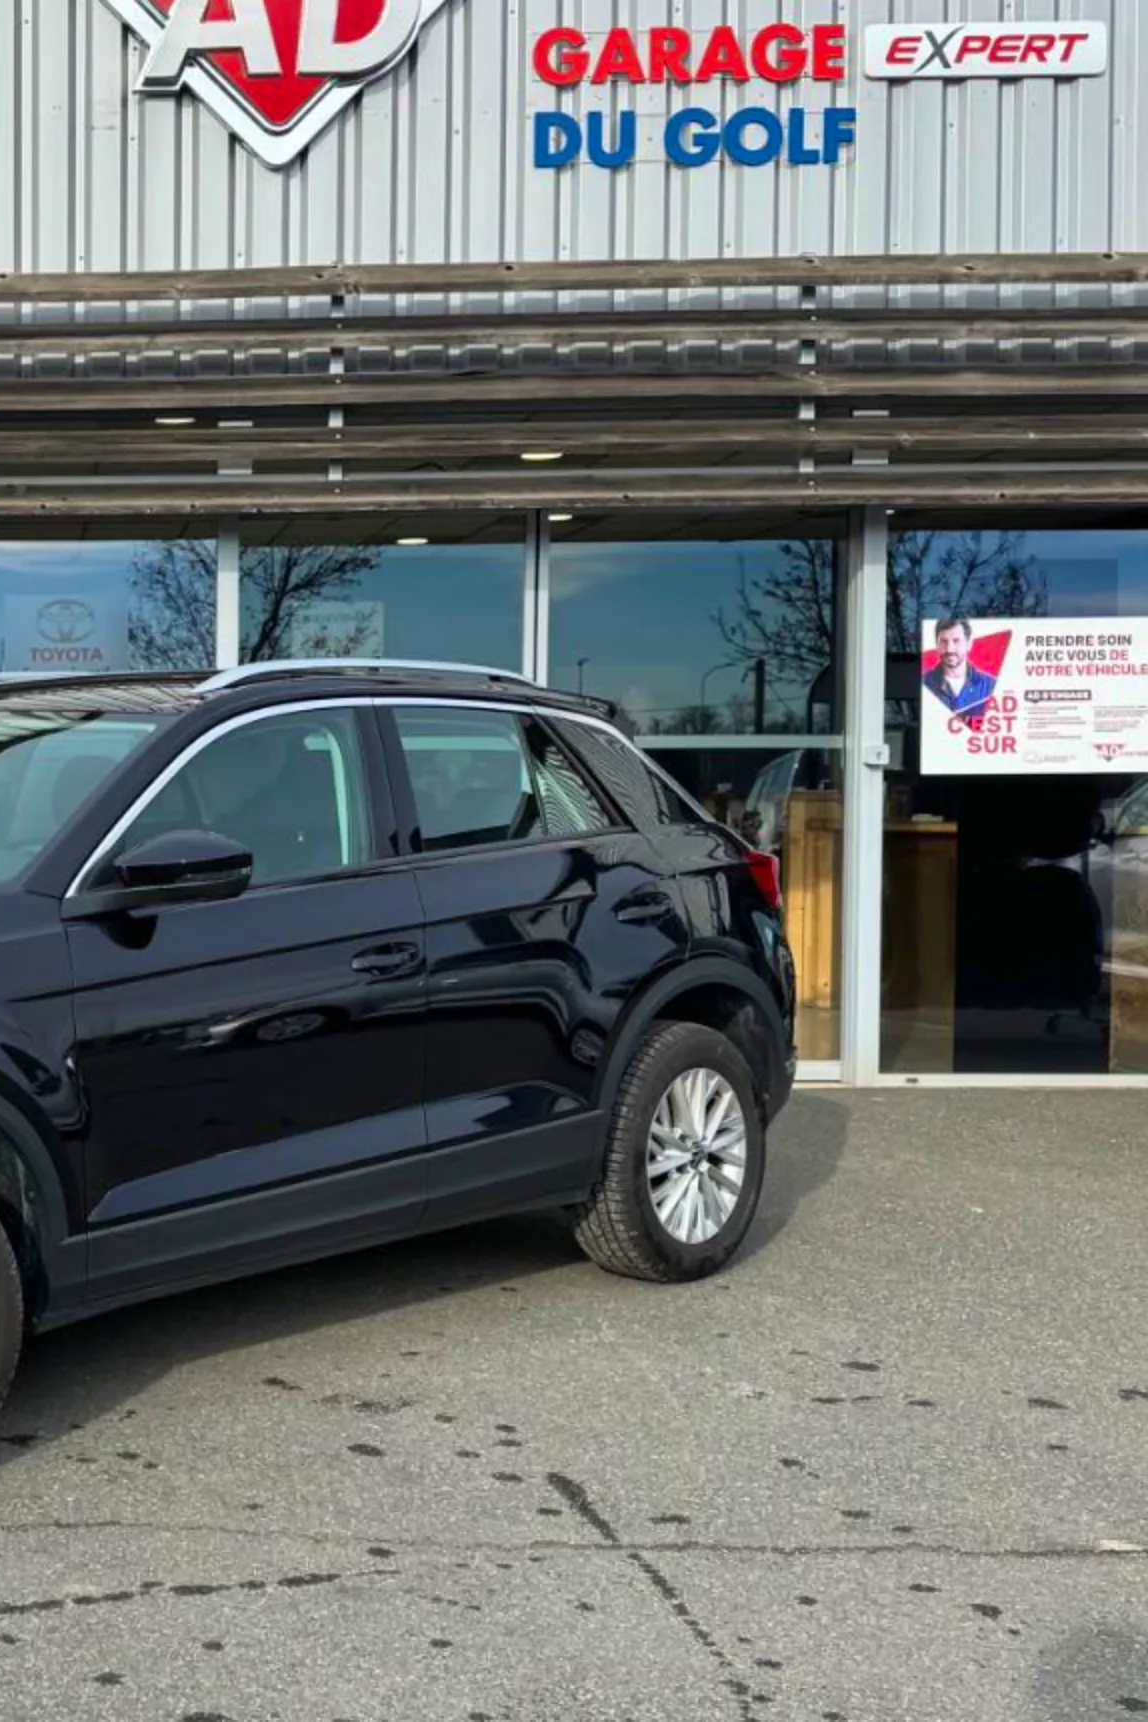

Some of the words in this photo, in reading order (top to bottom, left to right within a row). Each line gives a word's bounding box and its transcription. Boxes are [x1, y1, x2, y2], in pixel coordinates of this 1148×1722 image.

[533, 24, 845, 85] GARAGE
[886, 26, 1089, 73] EXPERT
[534, 110, 636, 169] DU
[664, 106, 856, 167] GOLF
[1025, 635, 1095, 647] PRENDRE
[1097, 634, 1133, 646] SOIN
[30, 647, 104, 662] TOYOTA
[1025, 649, 1065, 661] AVEC
[1066, 649, 1107, 661] VOUS
[1109, 649, 1129, 661] DE
[1025, 665, 1073, 677] VOTRE
[984, 696, 1018, 713] AD
[947, 715, 1017, 734] C'EST
